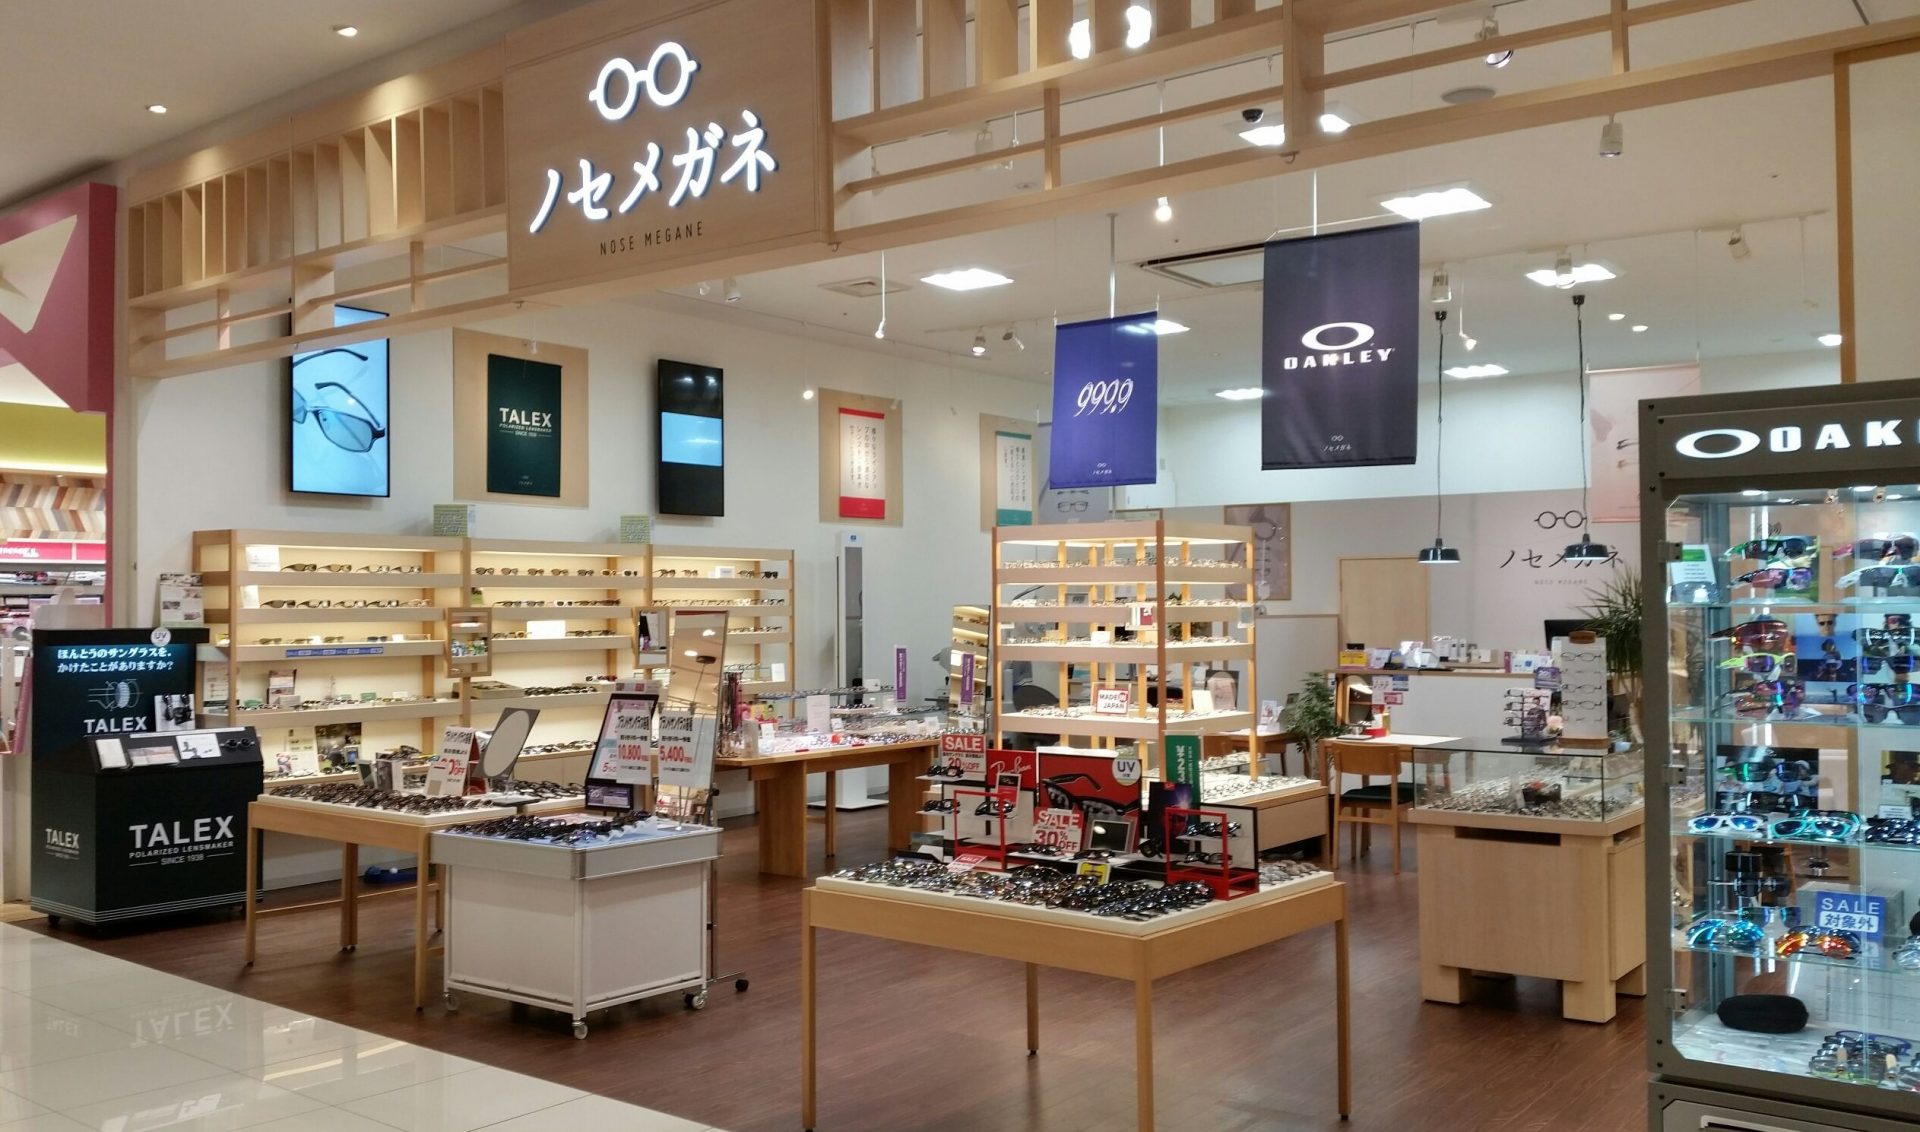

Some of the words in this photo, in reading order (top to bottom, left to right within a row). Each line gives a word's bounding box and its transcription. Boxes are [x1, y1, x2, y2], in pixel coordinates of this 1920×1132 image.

[528, 109, 778, 234] ノセメガネ
[599, 234, 635, 256] NOSE
[644, 220, 704, 246] MEGANE
[1283, 347, 1393, 370] OAKLEY
[1073, 378, 1134, 417] 999.9
[499, 407, 552, 428] TALEX
[1769, 419, 1920, 453] OAK
[1099, 693, 1119, 701] MADE
[1103, 702, 1125, 710] JAPAN
[83, 716, 148, 734] TALEX
[944, 736, 982, 752] SALE
[660, 744, 685, 763] 5,400
[1117, 761, 1136, 773] UV
[1037, 810, 1081, 828] SALE
[45, 828, 80, 849] TALEX
[129, 815, 234, 849] TALEX
[129, 847, 180, 859] POLARIZED
[182, 841, 234, 853] LENSMAKER
[1059, 841, 1078, 850] OFF
[160, 856, 185, 866] SINCE
[187, 853, 204, 863] 1938
[1821, 897, 1881, 915] SALE
[1824, 913, 1874, 931] 対象外
